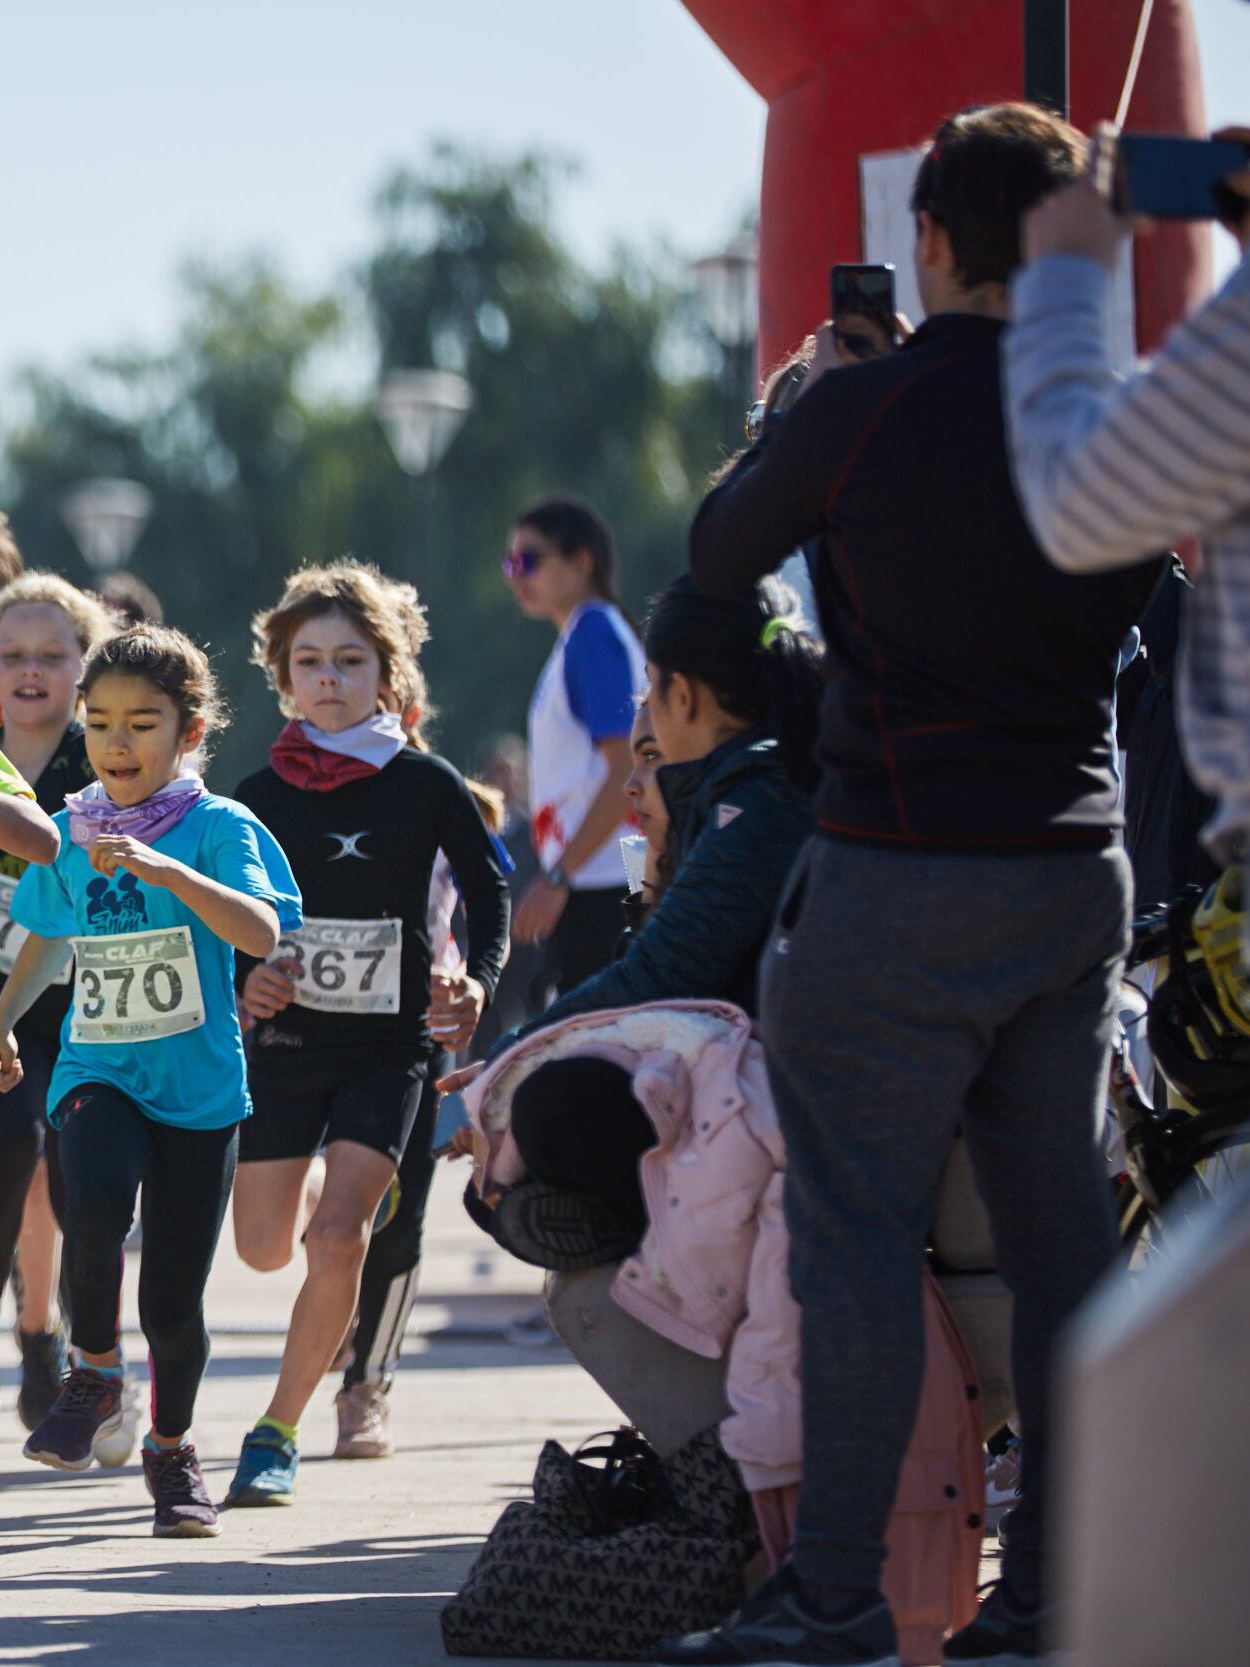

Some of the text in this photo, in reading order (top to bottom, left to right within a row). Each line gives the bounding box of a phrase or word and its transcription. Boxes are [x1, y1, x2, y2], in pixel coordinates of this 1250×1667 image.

[320, 929, 380, 945] CLAF
[105, 941, 165, 962] CLAF
[81, 962, 183, 1020] 370
